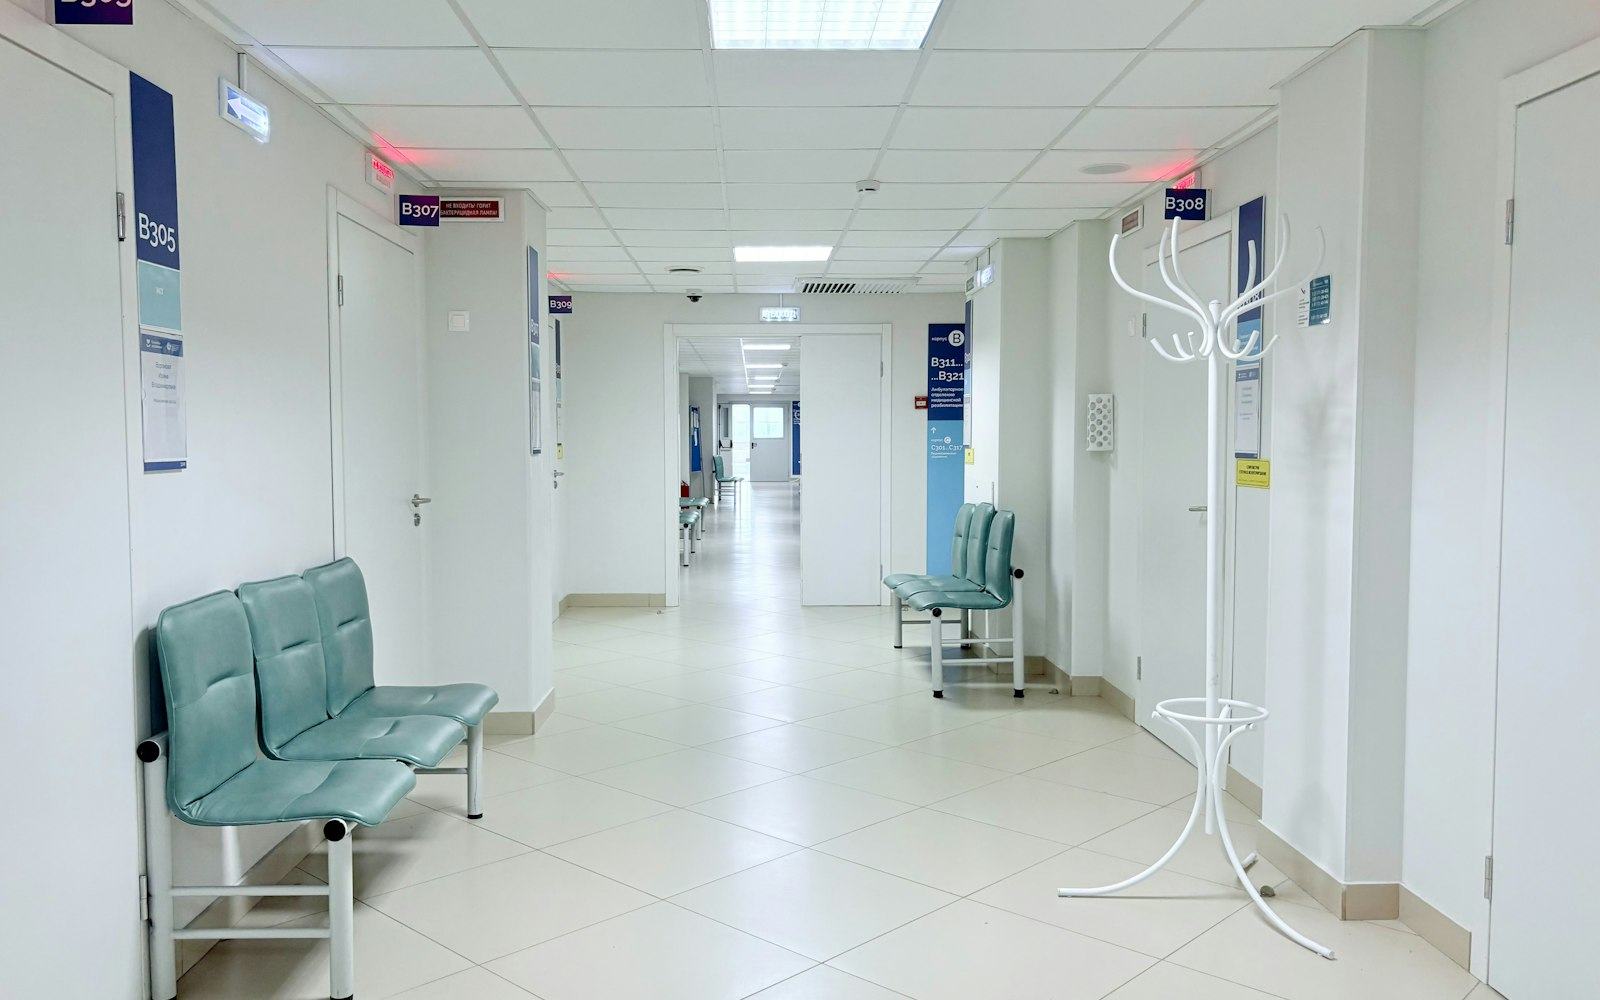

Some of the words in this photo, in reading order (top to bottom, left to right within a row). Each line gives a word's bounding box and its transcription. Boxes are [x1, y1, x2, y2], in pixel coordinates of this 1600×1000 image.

[402, 202, 439, 218] B307
[1165, 197, 1204, 212] B308
[138, 212, 176, 253] B305
[550, 300, 572, 309] B309
